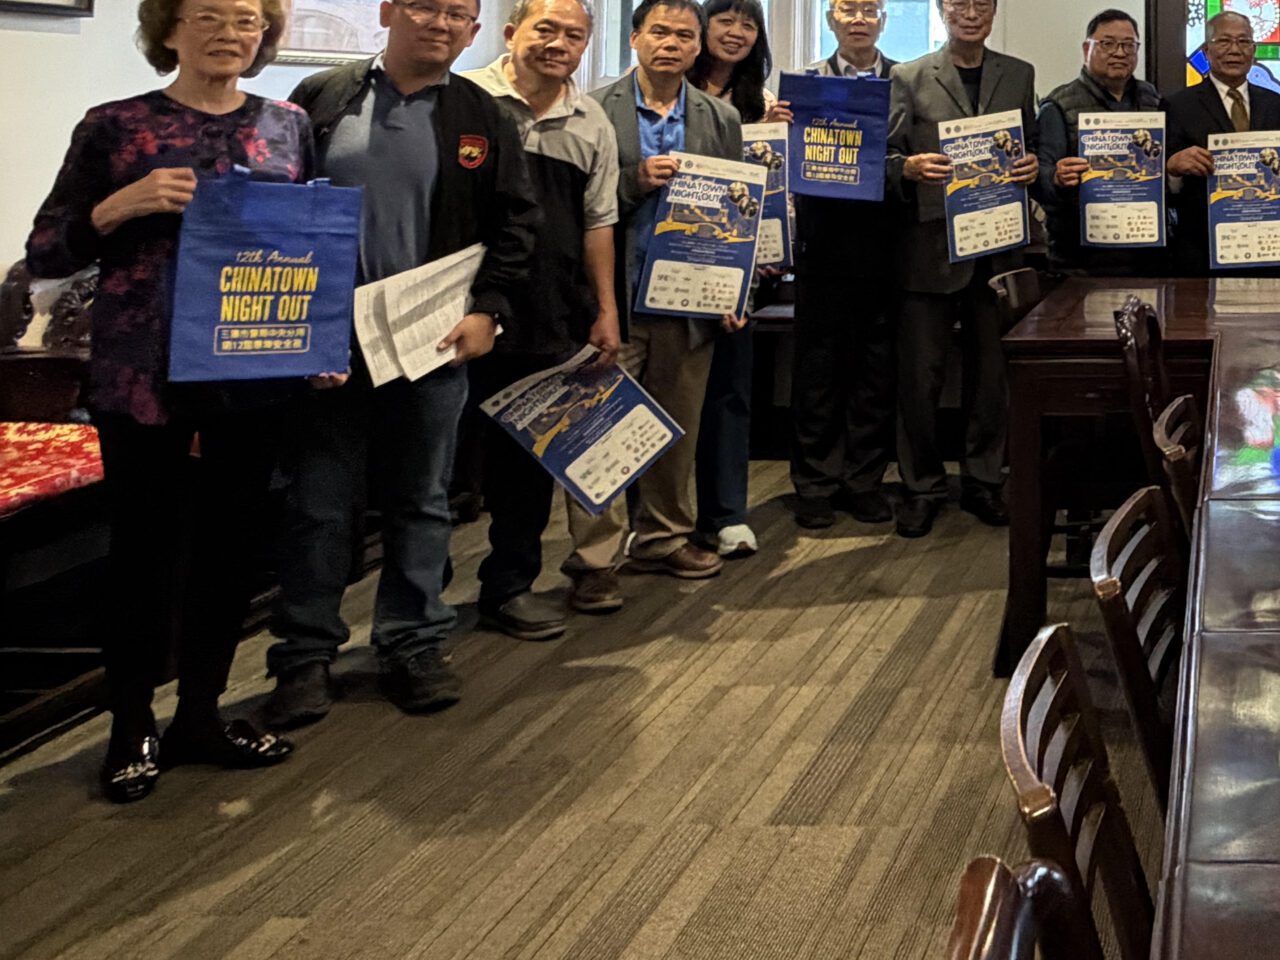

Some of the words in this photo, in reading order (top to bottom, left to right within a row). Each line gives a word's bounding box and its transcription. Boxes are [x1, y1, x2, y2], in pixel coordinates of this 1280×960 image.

[804, 127, 863, 146] CHINATOWN
[805, 145, 836, 162] NIGHT
[838, 146, 860, 164] OUT
[671, 189, 699, 200] NIGHT
[701, 192, 721, 202] OUT
[236, 249, 264, 264] 12th
[265, 250, 314, 265] Annual
[219, 266, 319, 292] CHINATOWN
[220, 295, 275, 322] NIGHT
[277, 295, 312, 321] OUT
